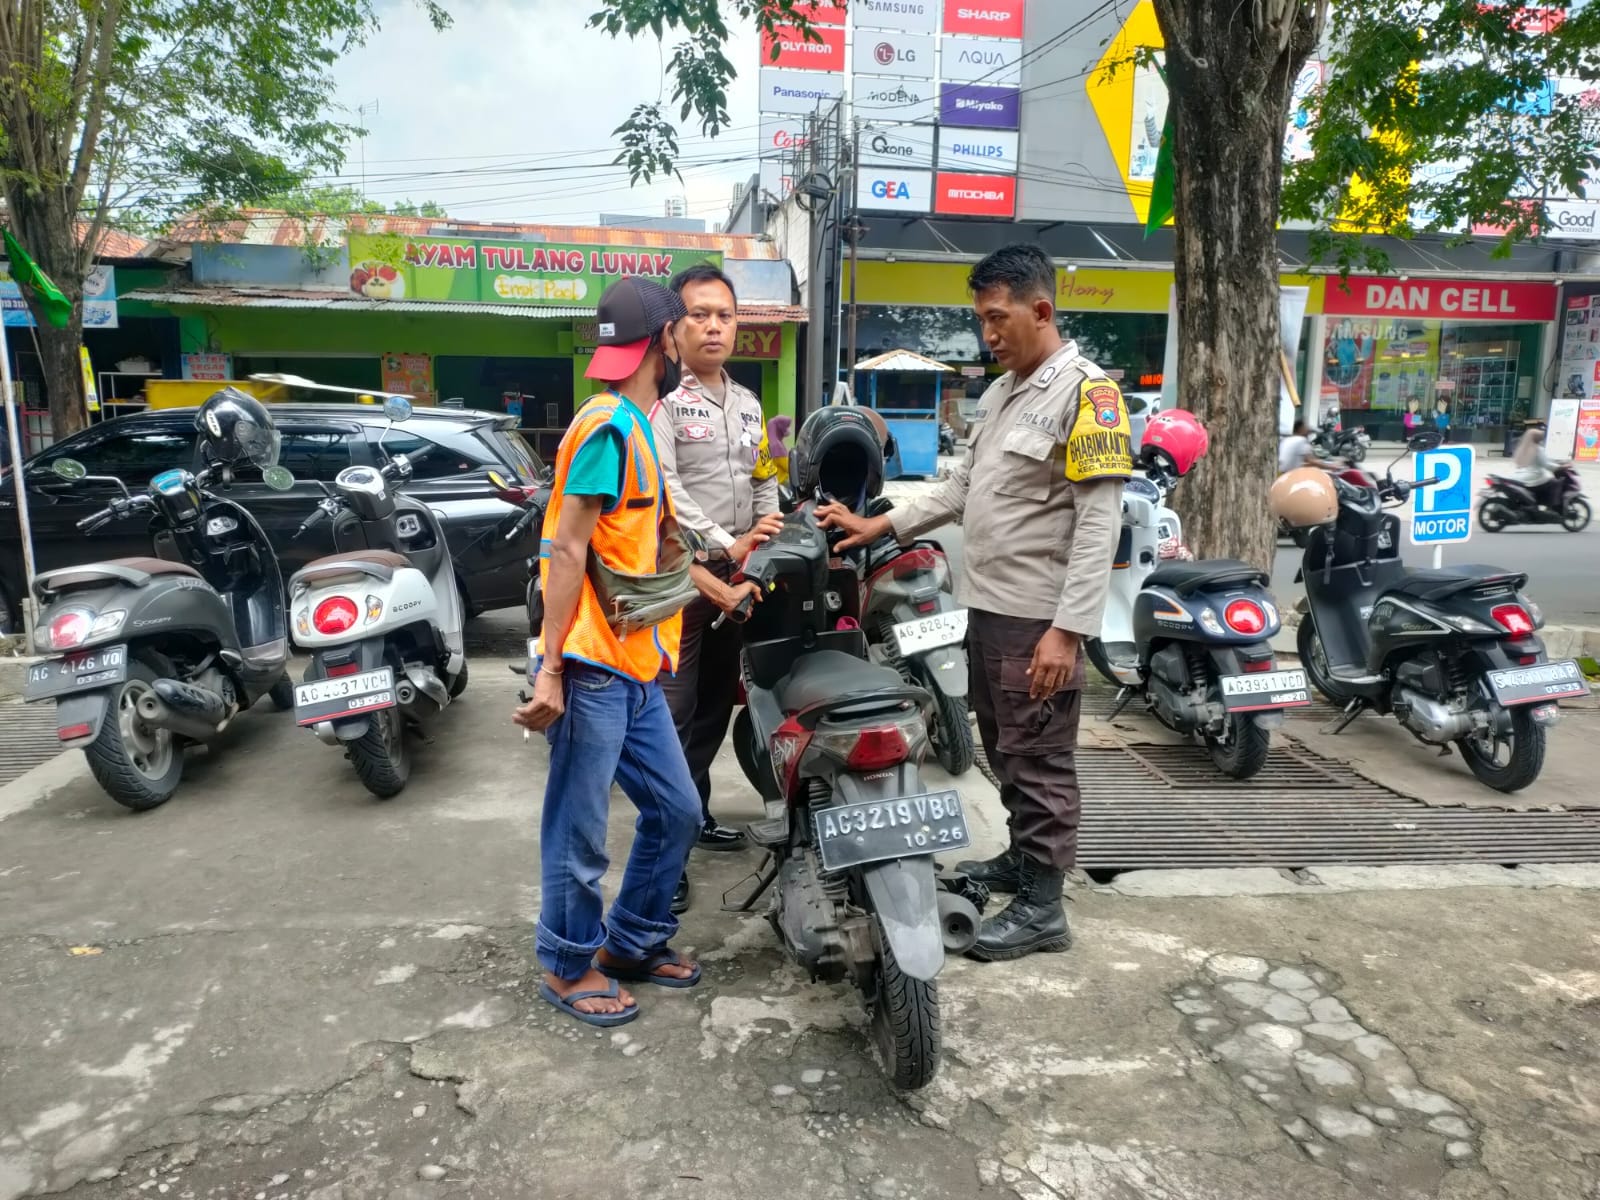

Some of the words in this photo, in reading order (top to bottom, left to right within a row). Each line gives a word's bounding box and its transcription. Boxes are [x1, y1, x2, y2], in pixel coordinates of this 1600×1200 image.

[867, 1, 924, 15] SAMSUNG
[957, 8, 1011, 21] SHARP
[776, 41, 832, 54] OLYTRON
[897, 49, 916, 62] LG
[958, 50, 1005, 65] AQUA
[773, 86, 830, 99] Panasonic
[965, 97, 1004, 112] Miyako
[871, 135, 913, 156] Oxone
[952, 143, 1004, 158] PHILIPS
[871, 180, 910, 199] GEA
[1558, 210, 1597, 228] Good
[405, 242, 476, 268] AYAM
[482, 245, 585, 274] TULANG
[590, 251, 673, 278] LUNAK
[1060, 274, 1115, 306] Homy
[1366, 284, 1430, 311] DAN
[1439, 287, 1516, 313] CELL
[1422, 452, 1462, 512] P
[1415, 518, 1467, 536] MOTOR
[392, 599, 422, 613] SCOOPY
[863, 771, 896, 782] HONDA
